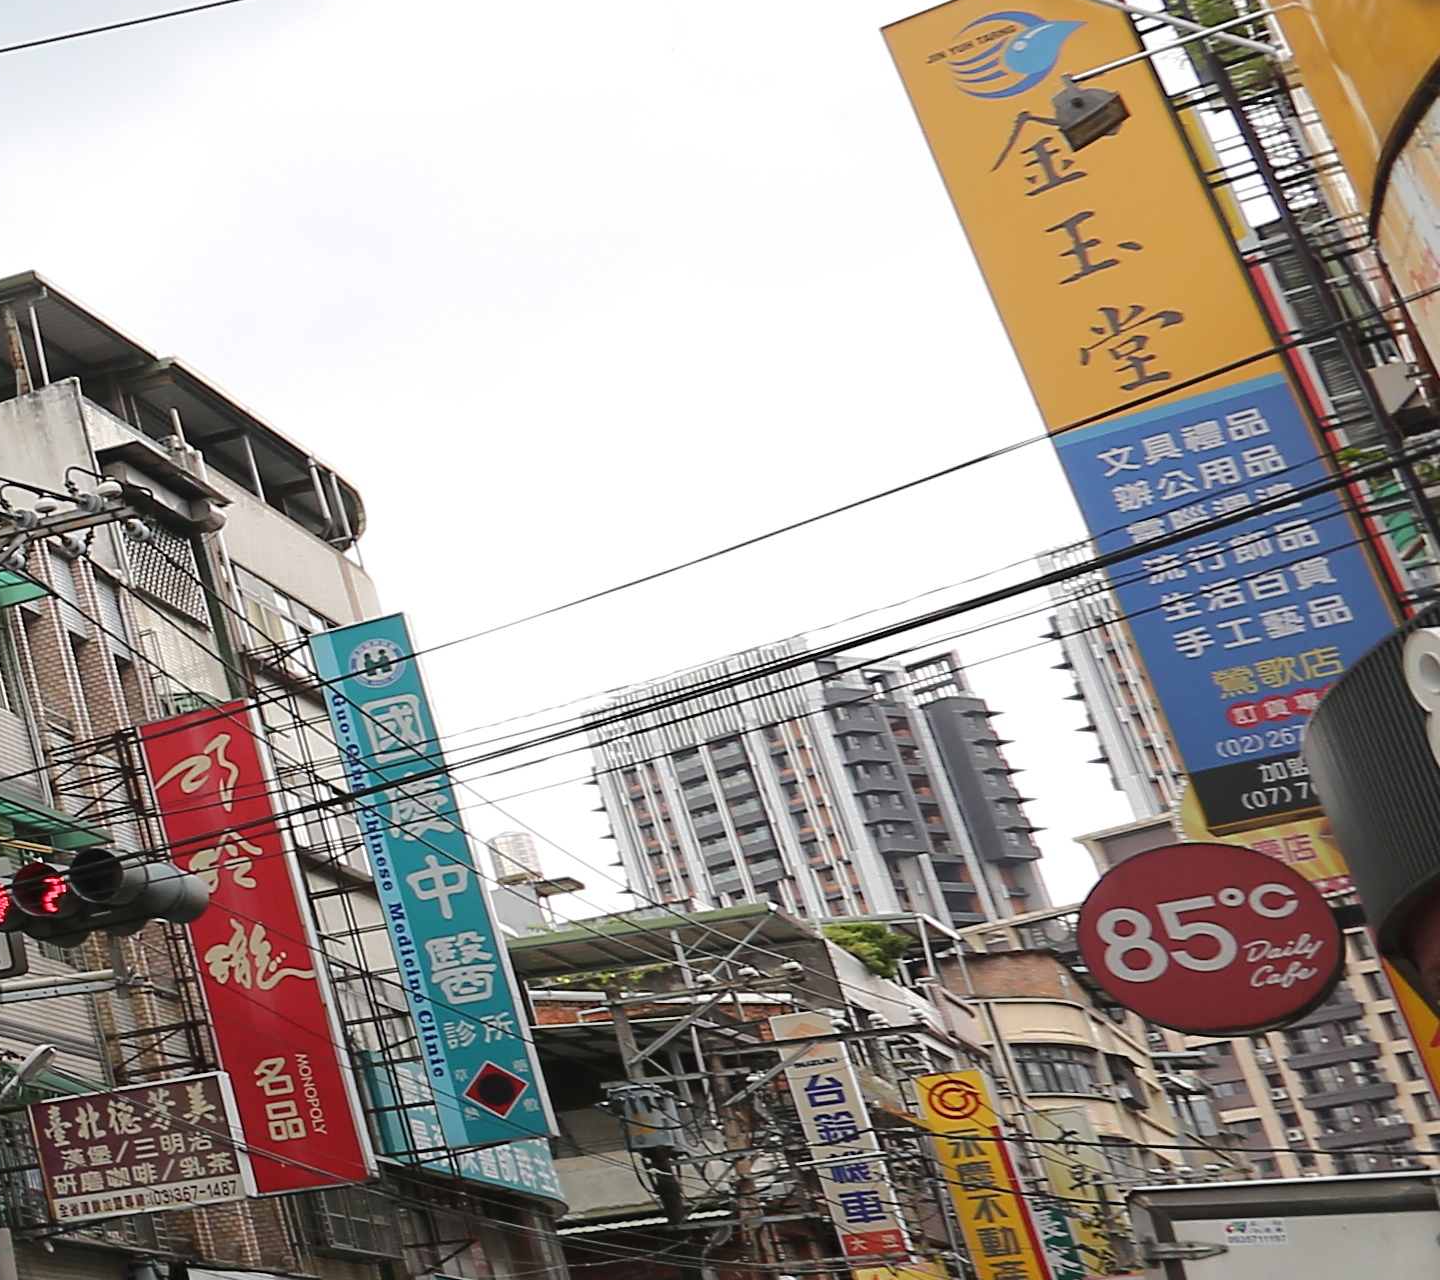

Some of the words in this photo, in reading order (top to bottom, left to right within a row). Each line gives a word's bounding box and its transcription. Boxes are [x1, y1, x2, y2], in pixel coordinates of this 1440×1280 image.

[1096, 407, 1272, 479] 文具禮品
[1112, 443, 1288, 513] 辦公用品
[1141, 517, 1321, 586] 流行飾品
[1159, 554, 1338, 623] 生活百貨
[1172, 593, 1355, 660] 手工藝品
[1211, 645, 1345, 700] 鶯歌店
[359, 694, 498, 1006] 國慶中醫
[444, 1010, 518, 1050] 診所
[1095, 880, 1301, 984] 85°C
[1243, 933, 1324, 967] Daily
[387, 902, 424, 1004] Medicine
[416, 1008, 447, 1081] Clinic
[1249, 965, 1319, 991] Cafe
[253, 1056, 308, 1143] 名品
[294, 1052, 328, 1137] MONOPOLY
[803, 1074, 887, 1224] 台鈴機車
